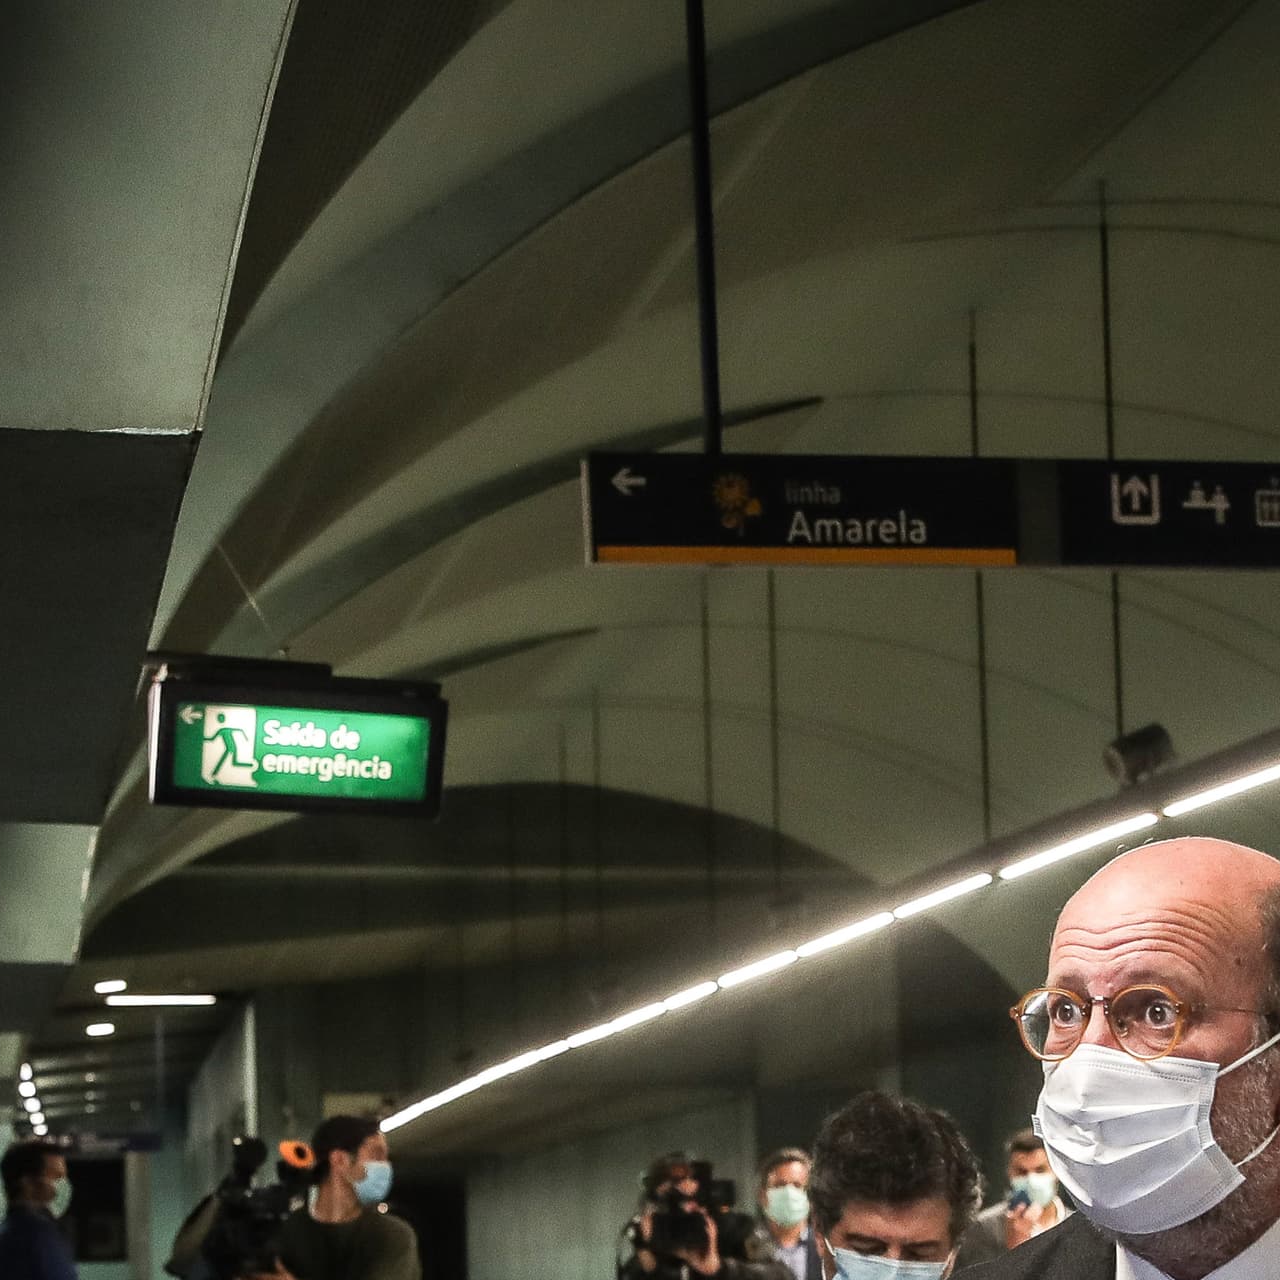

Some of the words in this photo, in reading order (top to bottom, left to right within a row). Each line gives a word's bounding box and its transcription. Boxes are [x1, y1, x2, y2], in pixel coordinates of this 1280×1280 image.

[784, 481, 841, 504] linha
[786, 508, 928, 545] Amarela
[263, 719, 327, 749] Saída
[329, 724, 360, 751] de
[261, 753, 393, 782] emergência
